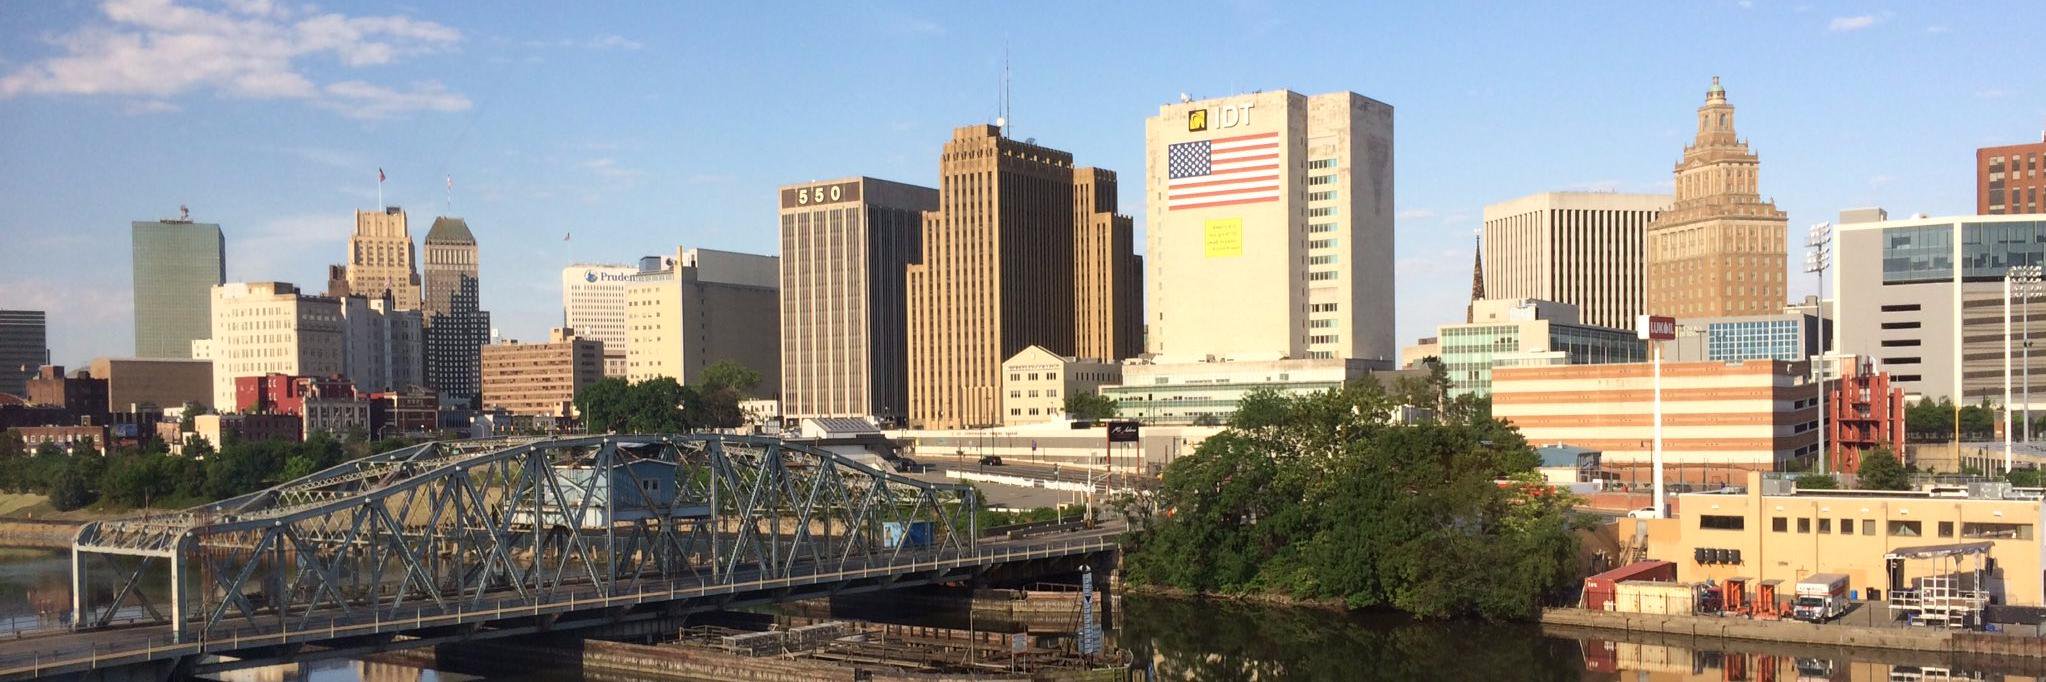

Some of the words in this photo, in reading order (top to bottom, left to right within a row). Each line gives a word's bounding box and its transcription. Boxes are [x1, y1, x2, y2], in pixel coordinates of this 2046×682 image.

[1215, 103, 1255, 130] IDT
[799, 185, 841, 205] 550
[1650, 321, 1674, 335] LUKOIL
